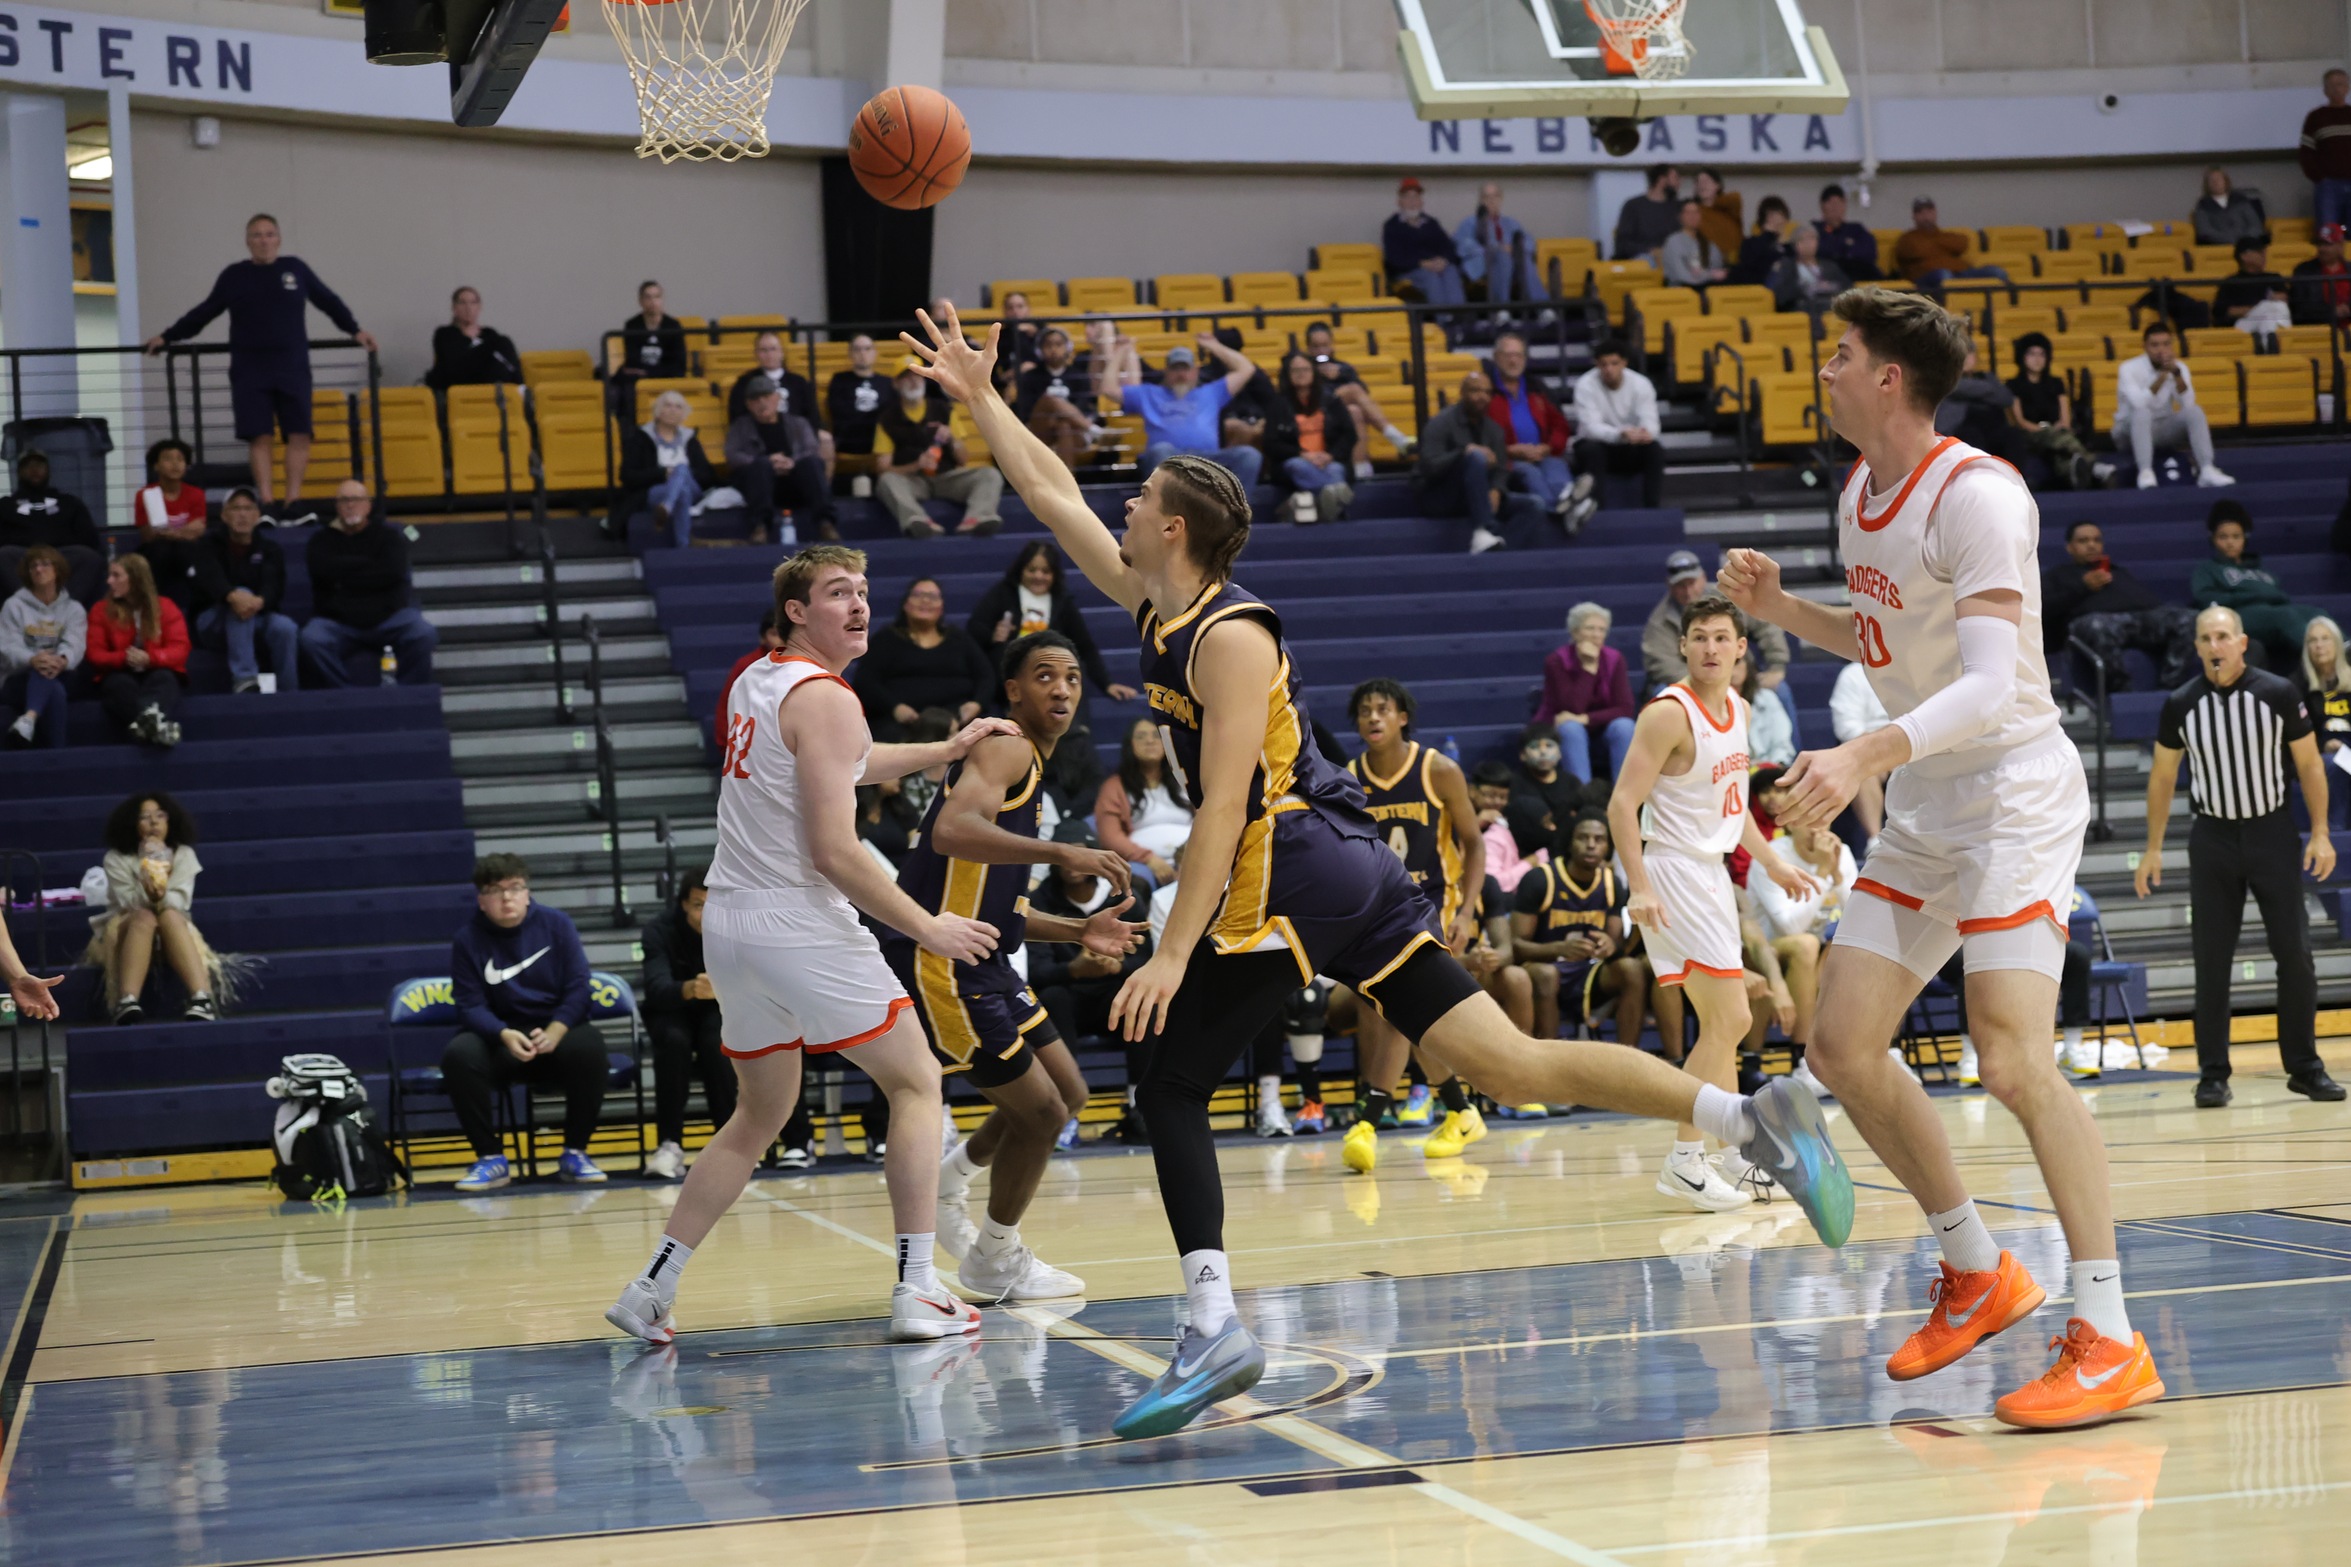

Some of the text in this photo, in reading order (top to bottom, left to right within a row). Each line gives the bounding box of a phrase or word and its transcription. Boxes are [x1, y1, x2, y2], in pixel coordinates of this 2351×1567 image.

[1429, 113, 1832, 153] NEBASKA
[1844, 564, 1904, 610] ADGERS
[1854, 611, 1892, 669] 30
[1722, 781, 1743, 818] 10
[1194, 1275, 1221, 1285] PEAK
